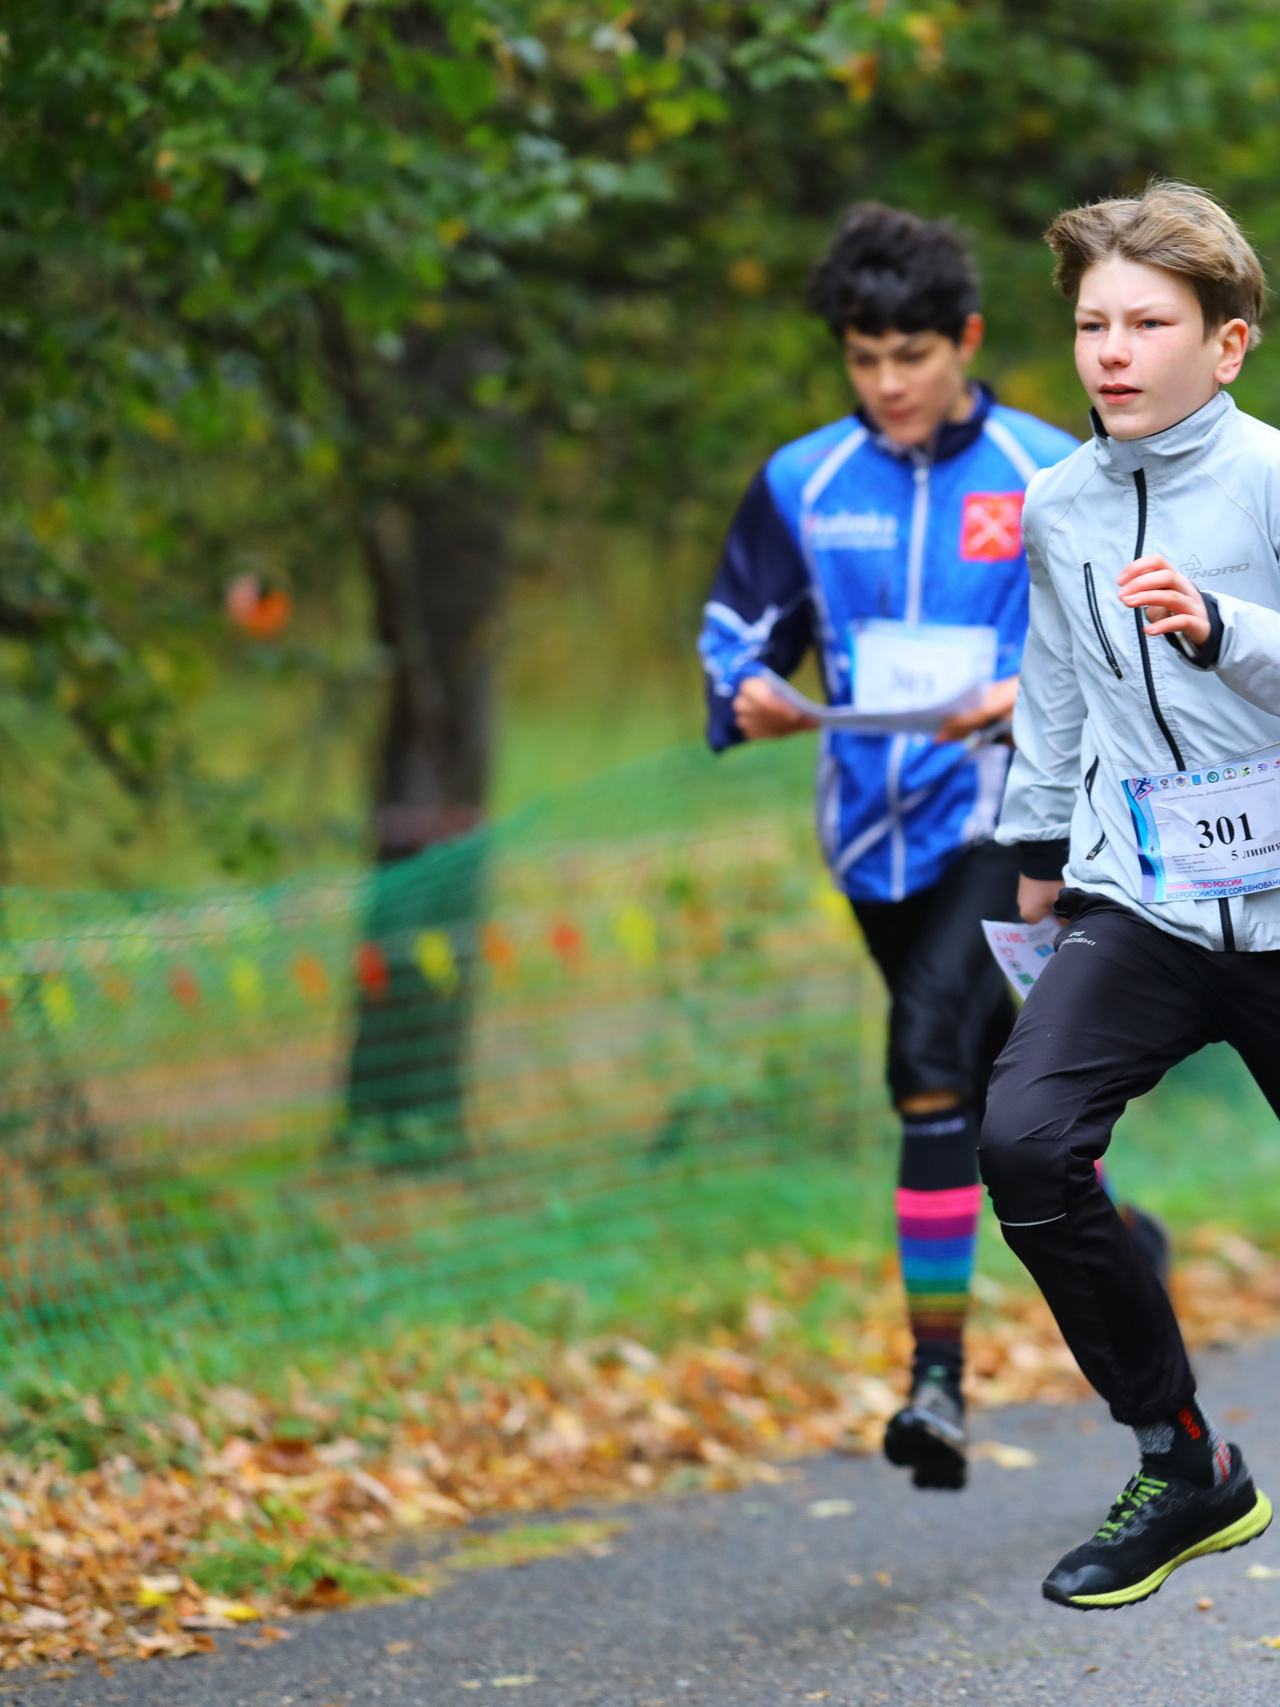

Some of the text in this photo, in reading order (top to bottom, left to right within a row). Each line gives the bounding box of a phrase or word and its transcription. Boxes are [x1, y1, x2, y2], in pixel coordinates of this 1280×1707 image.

[1192, 562, 1250, 580] NORD
[1196, 812, 1256, 849] 301
[1231, 850, 1240, 861] 5
[1165, 877, 1243, 892] ПЕРВЕНСТВО РОССИИ
